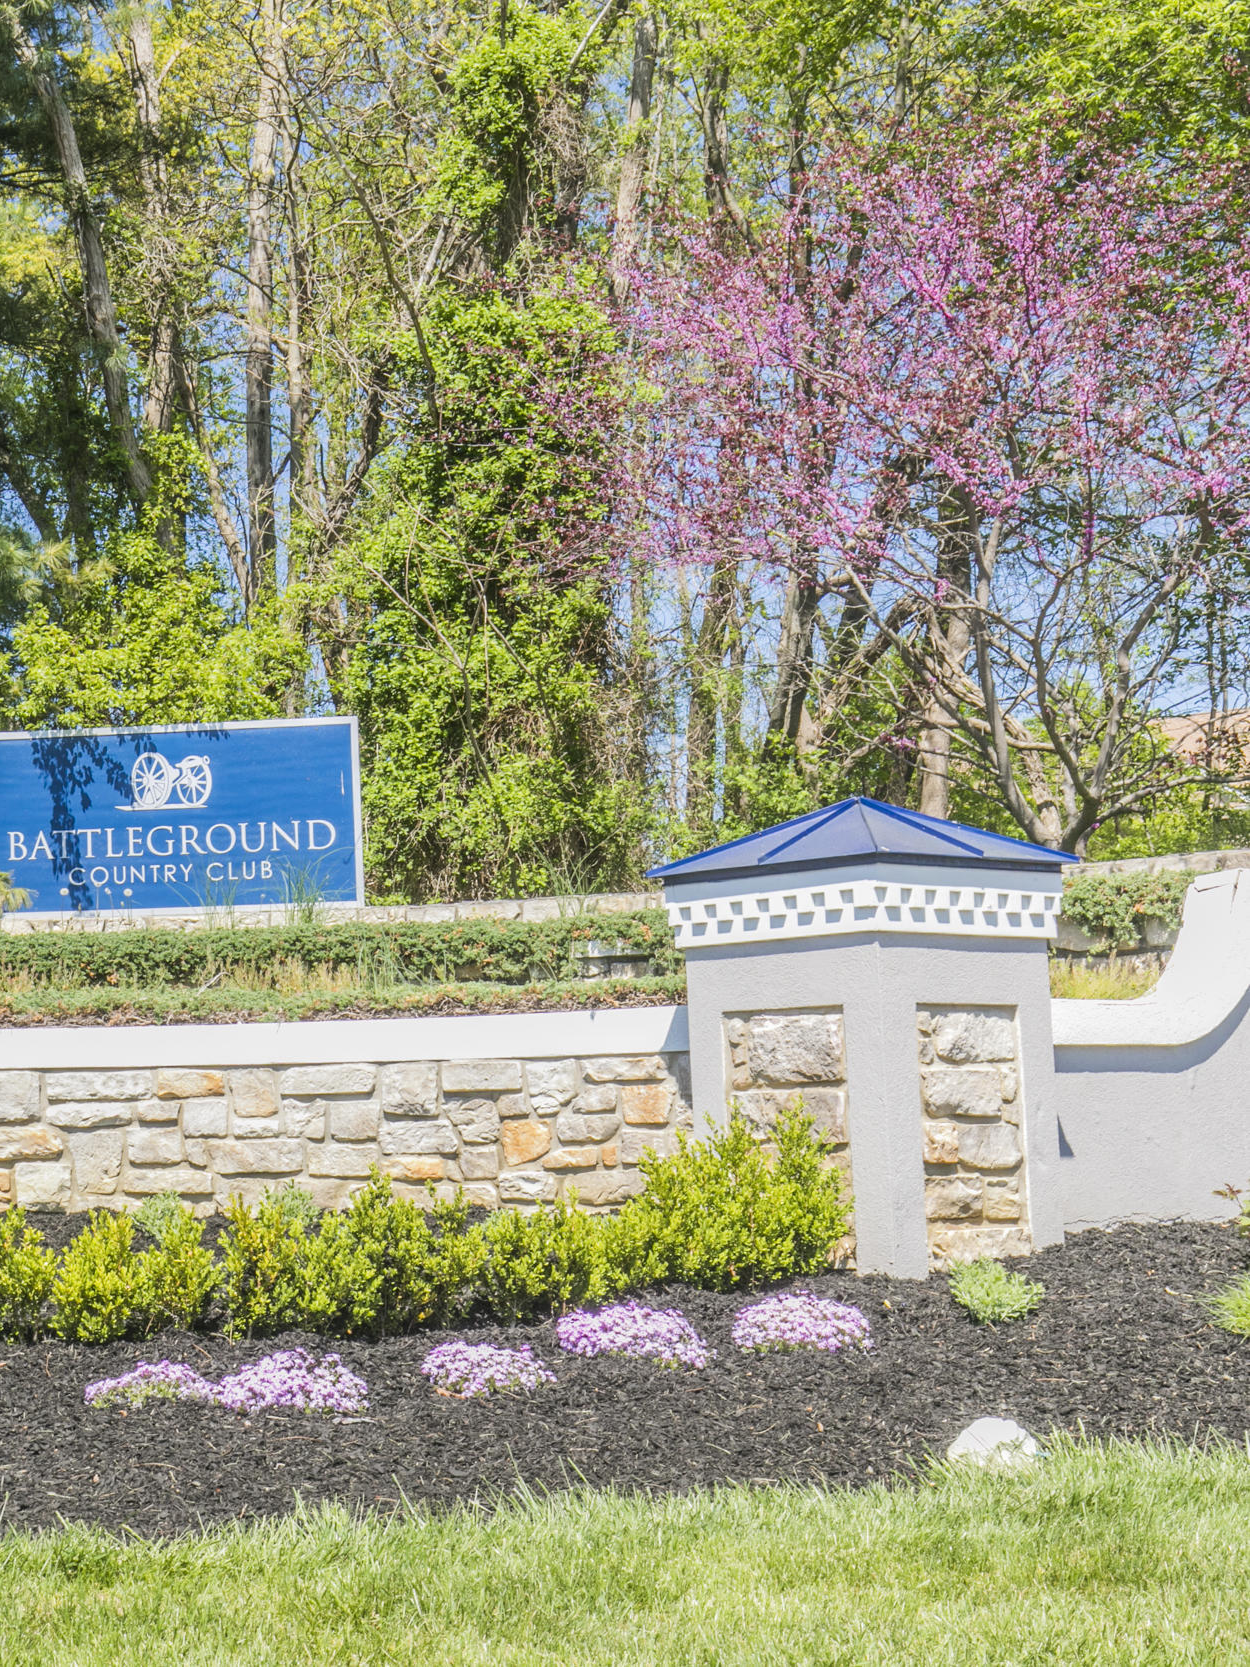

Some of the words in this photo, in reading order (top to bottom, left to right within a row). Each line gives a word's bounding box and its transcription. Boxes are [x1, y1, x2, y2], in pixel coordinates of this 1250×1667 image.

[7, 819, 336, 861] BATTLEGROUND
[69, 862, 193, 886] COUNTRY
[206, 860, 274, 882] CLUB
